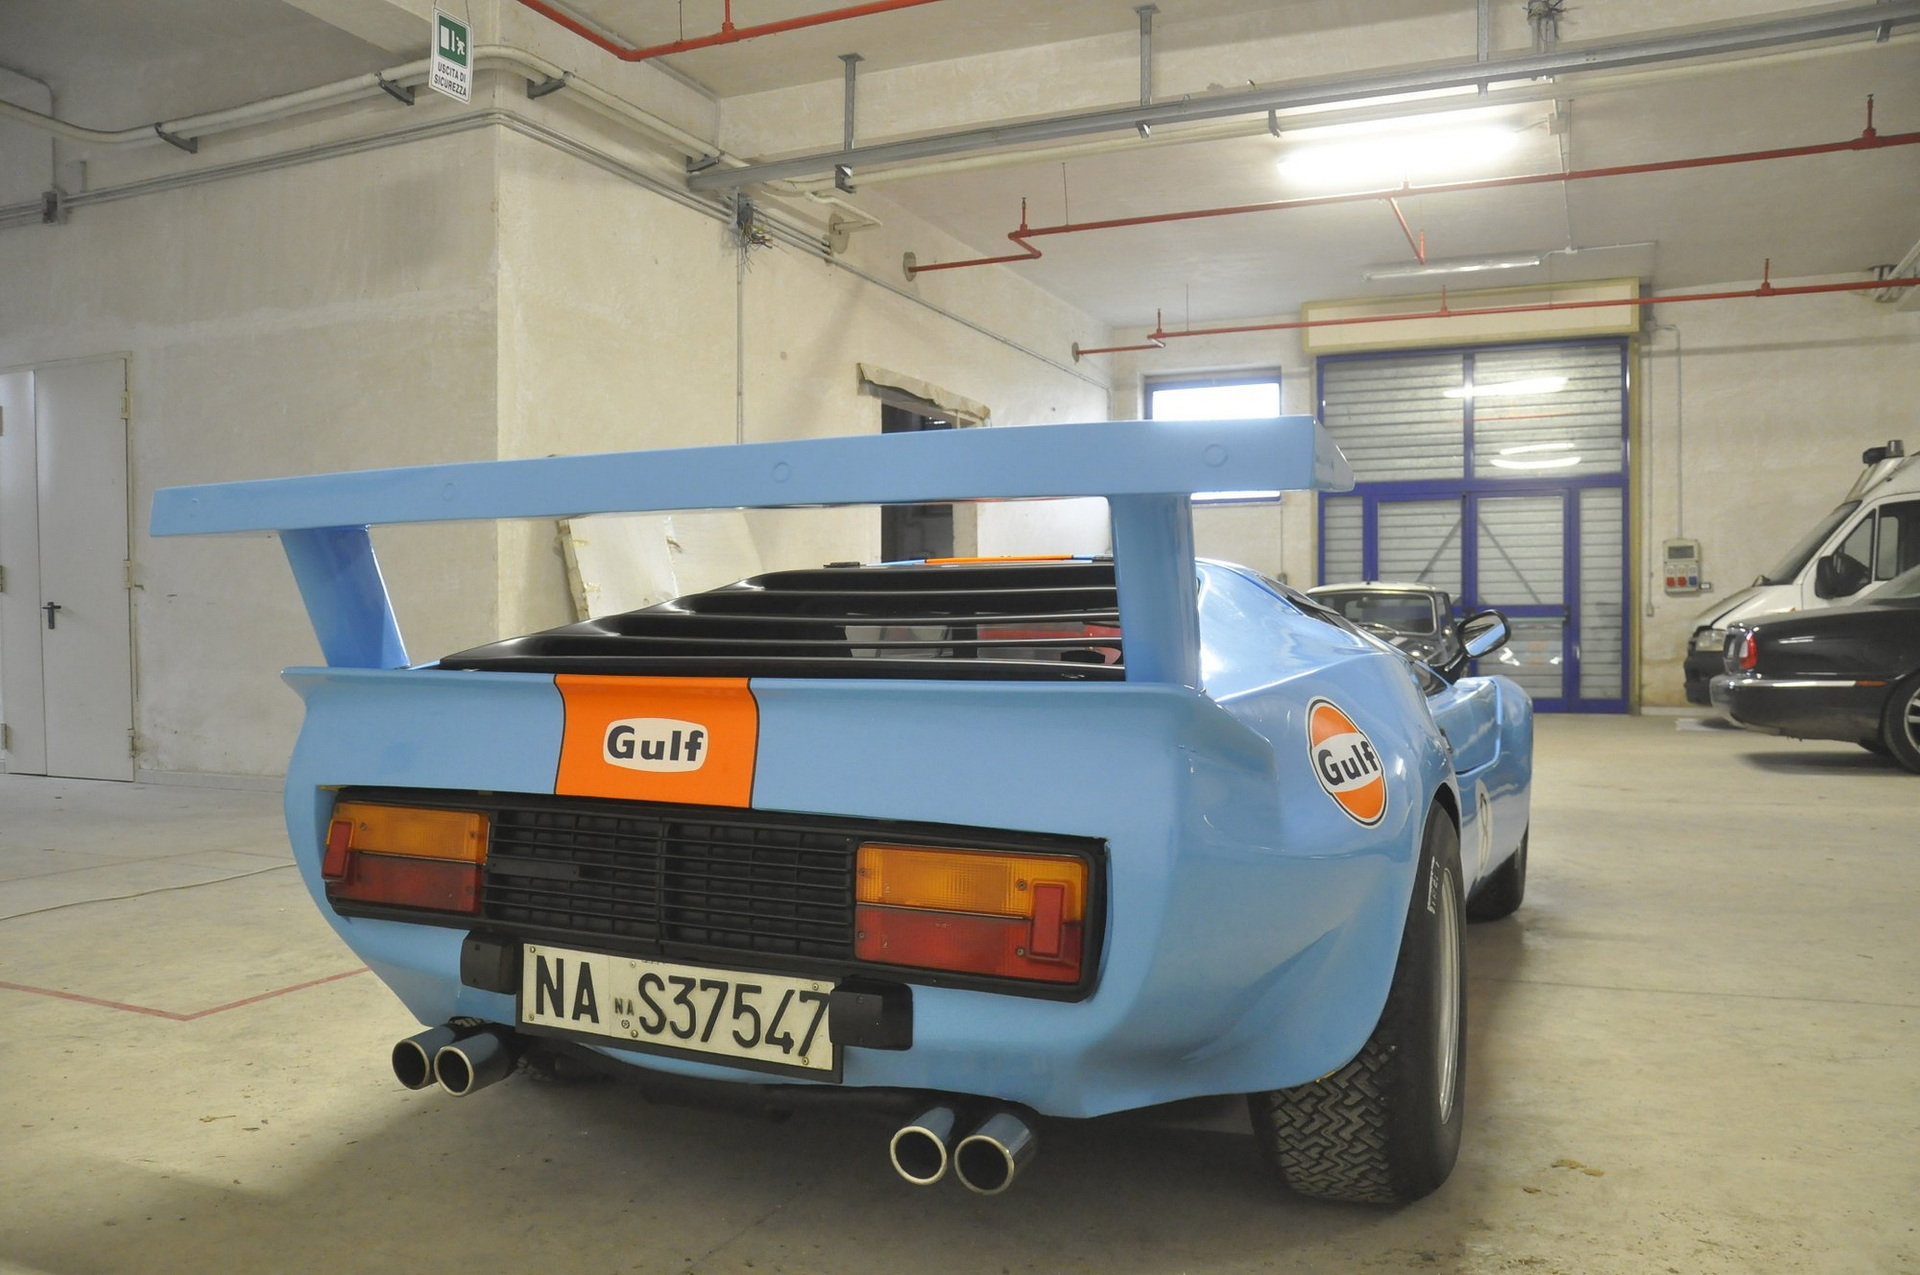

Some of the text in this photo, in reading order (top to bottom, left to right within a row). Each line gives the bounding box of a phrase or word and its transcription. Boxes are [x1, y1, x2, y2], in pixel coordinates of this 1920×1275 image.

[434, 74, 466, 96] SICUREZZA
[438, 61, 466, 83] USCITA DI
[607, 725, 704, 762] Gulf
[1317, 740, 1379, 786] Gulf
[535, 955, 830, 1057] NA NA S37547
